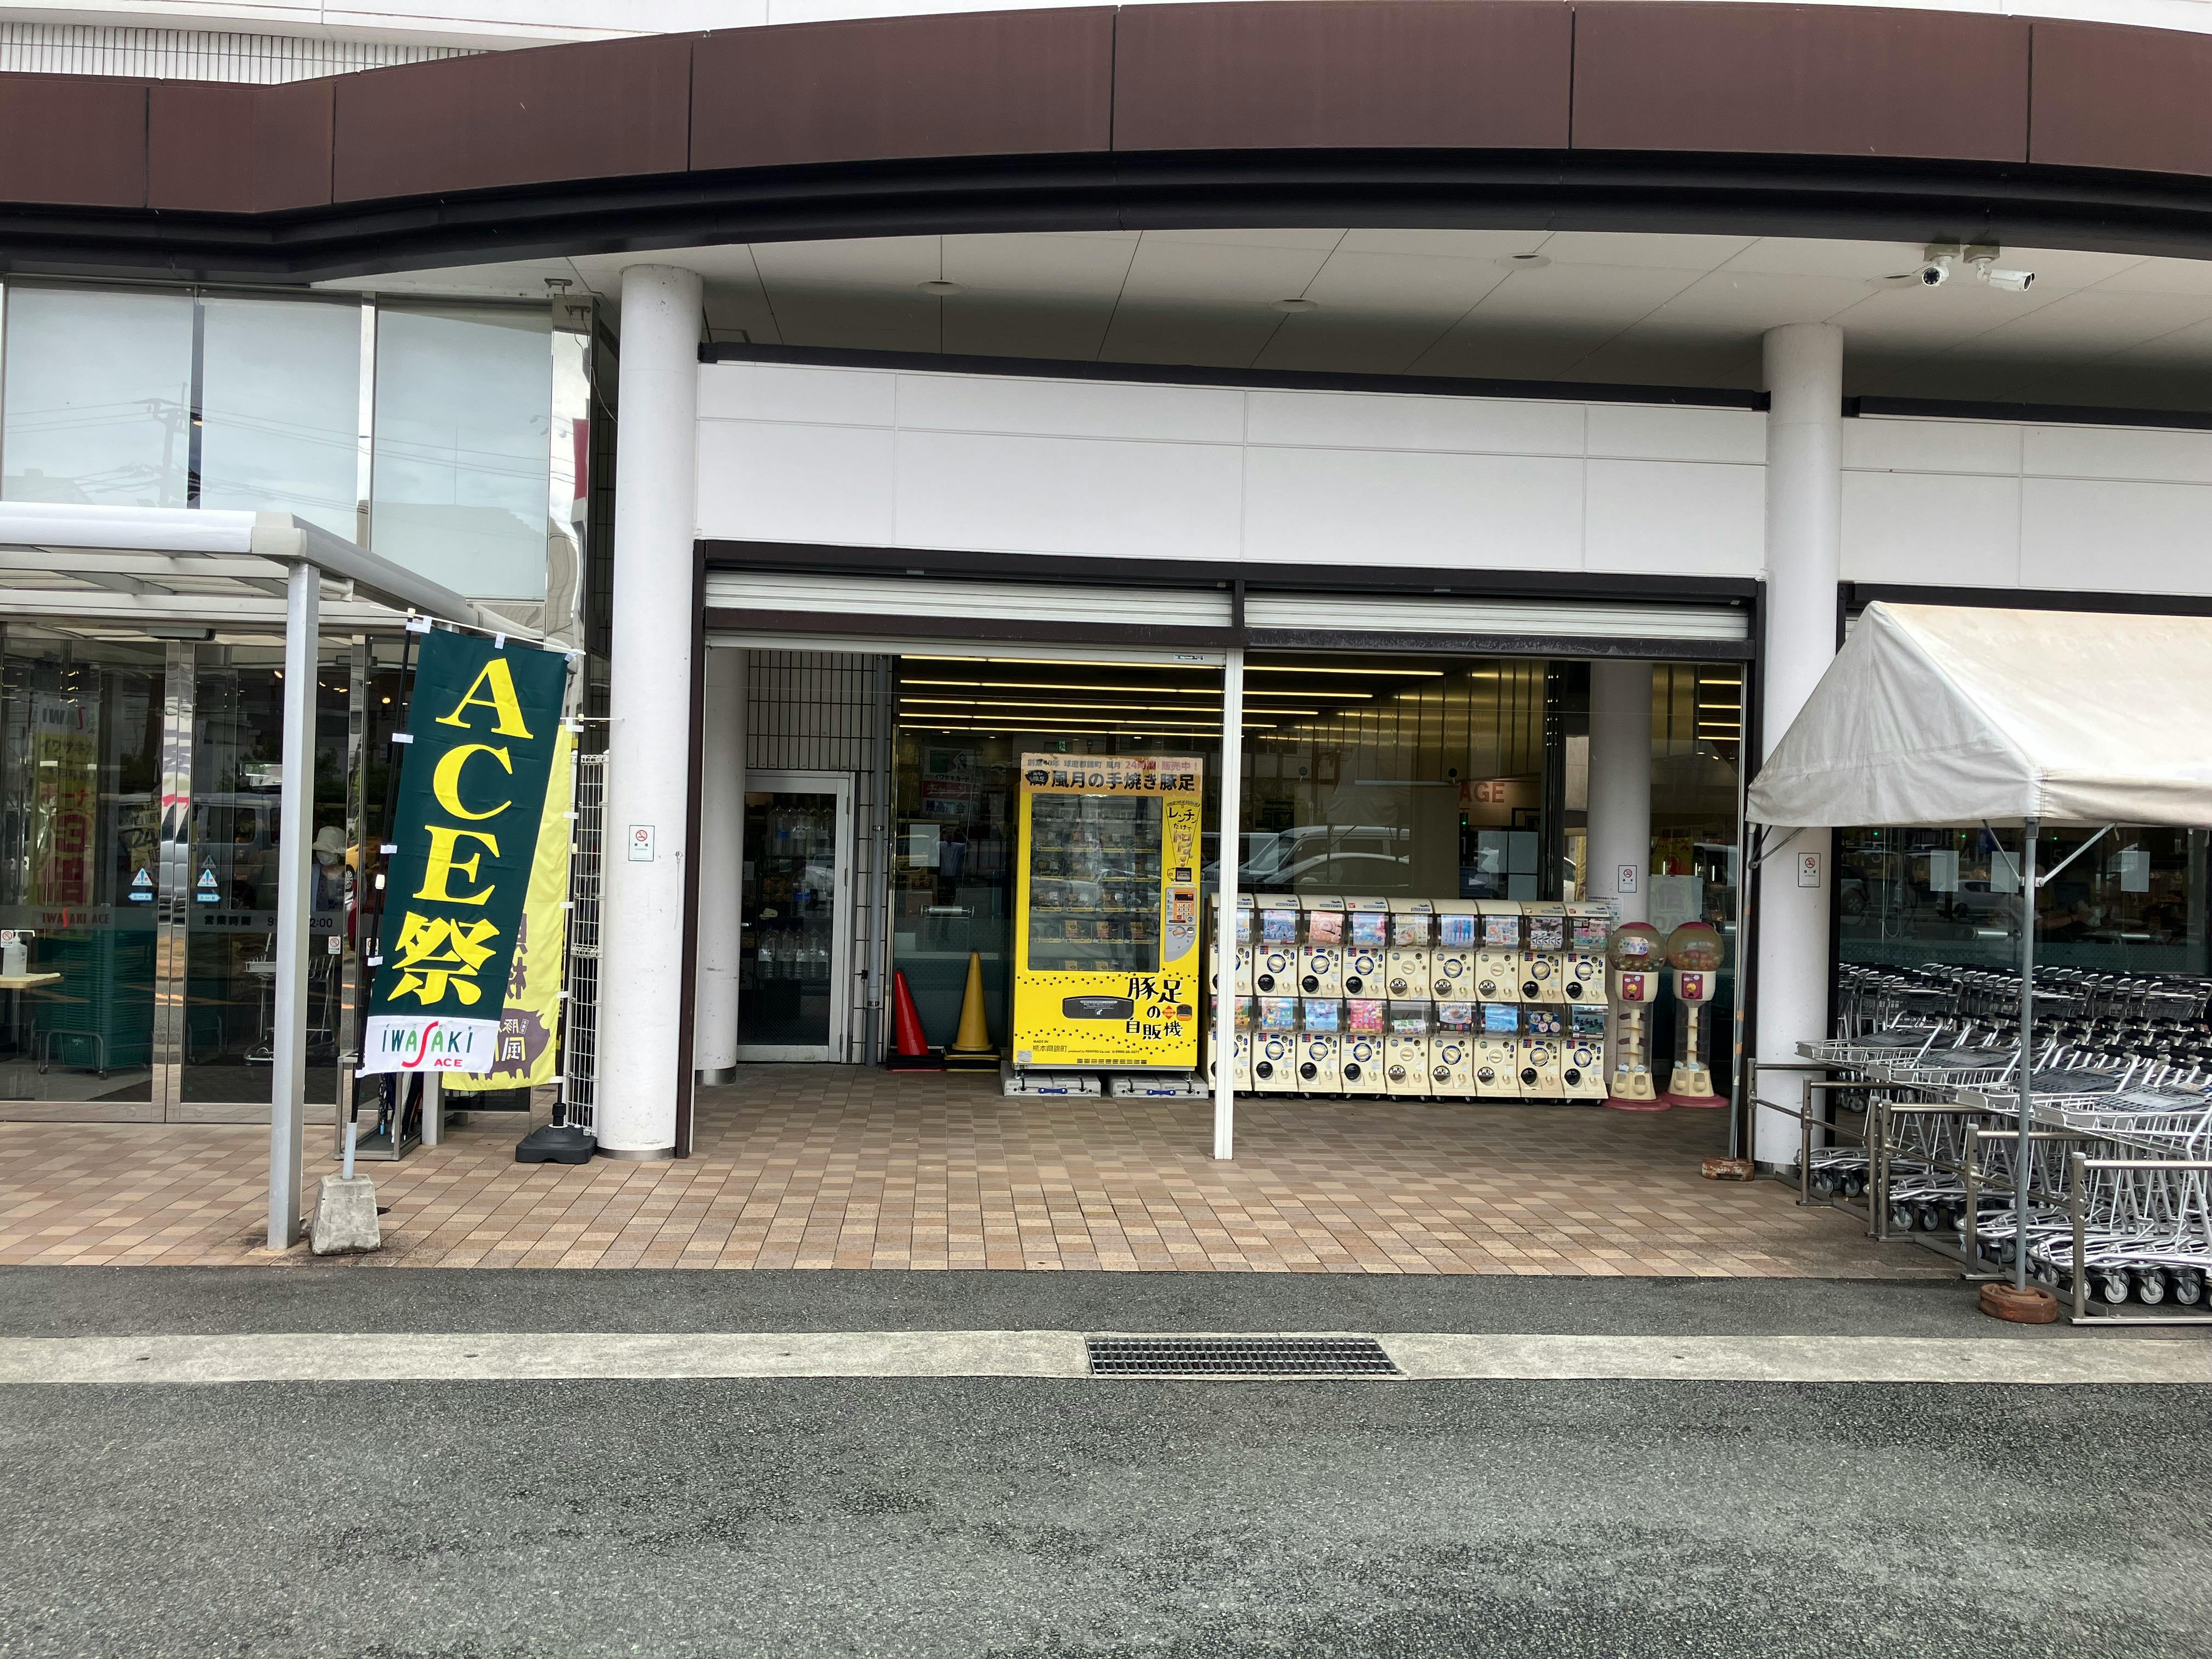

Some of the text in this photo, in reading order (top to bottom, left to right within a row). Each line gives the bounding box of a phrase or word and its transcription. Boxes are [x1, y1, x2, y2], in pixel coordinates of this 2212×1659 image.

[1051, 770, 1195, 792] 風月の手焼き豚足
[1169, 807, 1197, 823] レンチン
[388, 658, 533, 1006] ACE祭
[42, 908, 110, 928] IWASAKI ACE
[205, 915, 251, 927] 営業時間
[1127, 977, 1182, 1003] 豚足
[1147, 1006, 1161, 1018] の
[1126, 1017, 1183, 1040] 自販機
[382, 1020, 473, 1068] IWASAKI
[1033, 1045, 1067, 1053] 熊本県錦町
[434, 1059, 463, 1067] ACE
